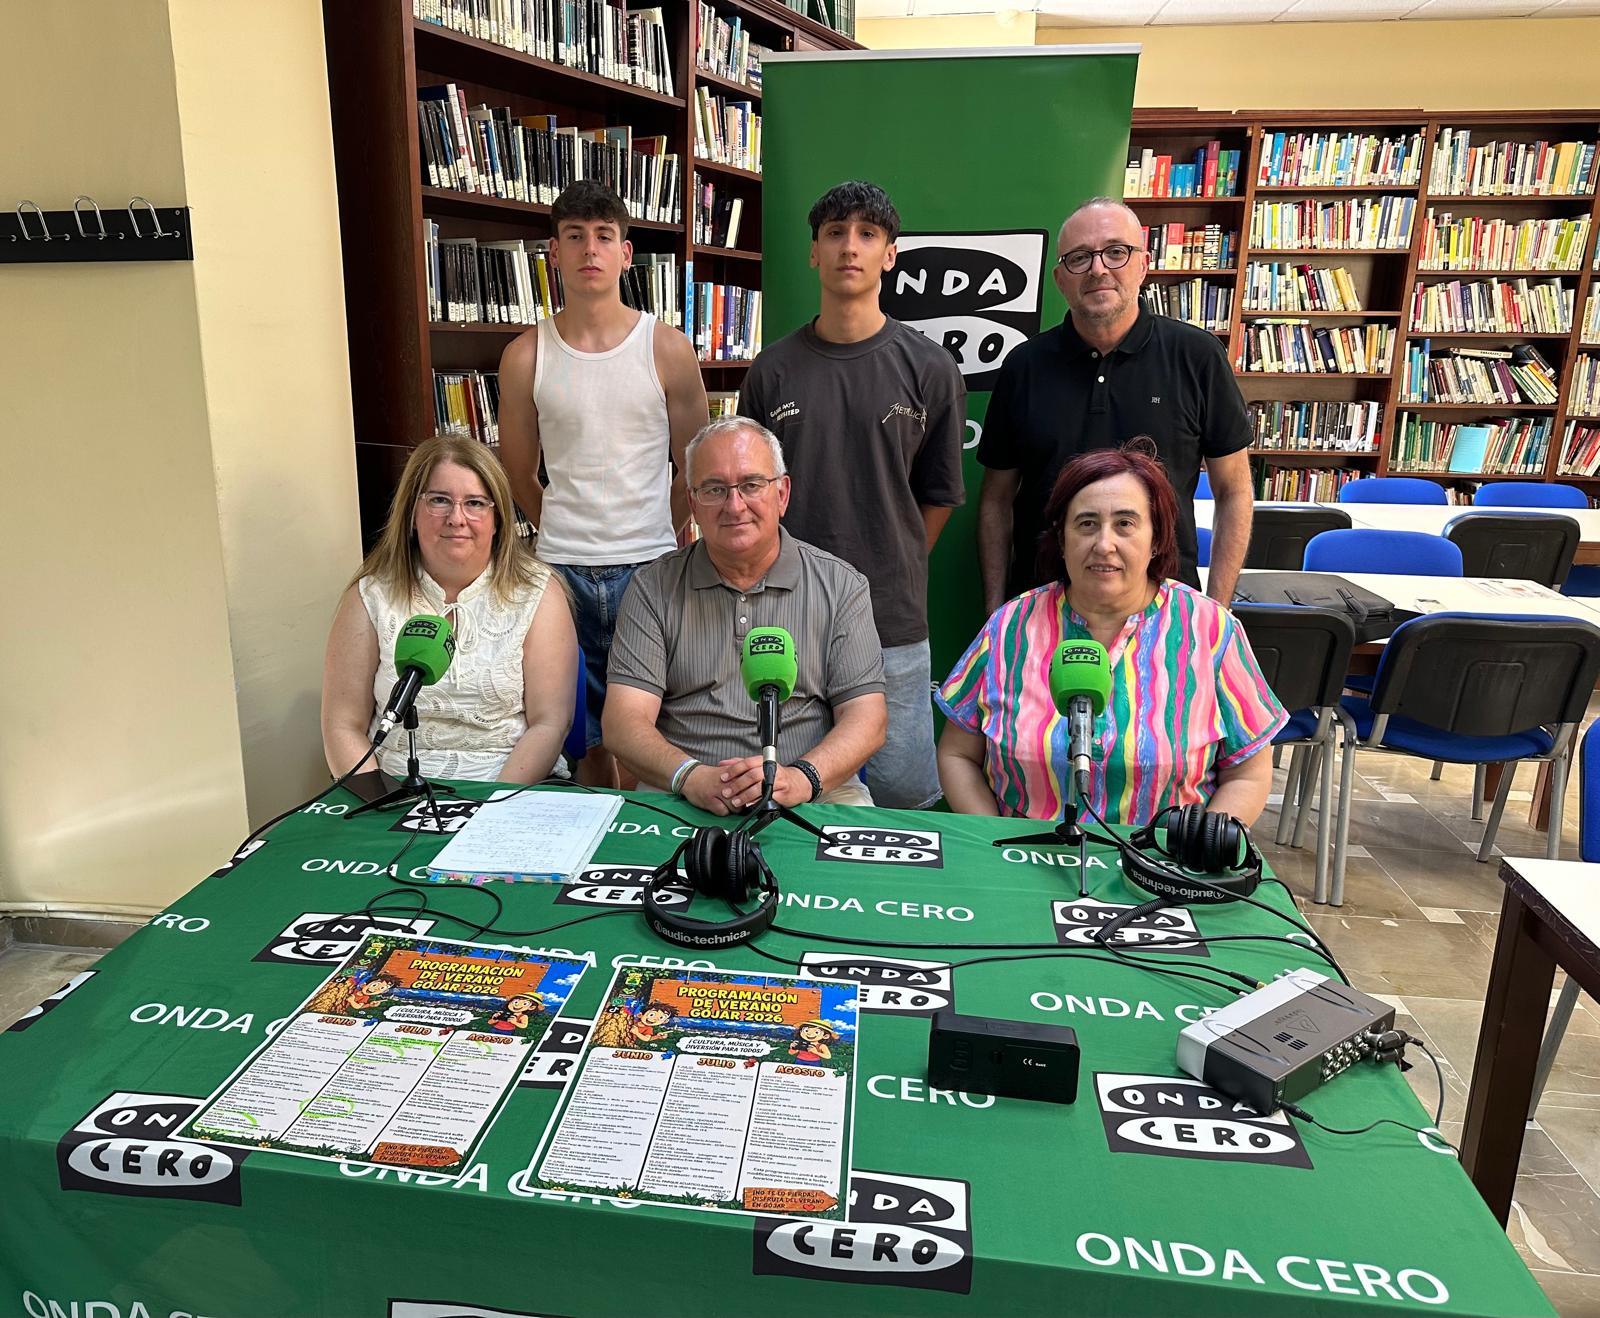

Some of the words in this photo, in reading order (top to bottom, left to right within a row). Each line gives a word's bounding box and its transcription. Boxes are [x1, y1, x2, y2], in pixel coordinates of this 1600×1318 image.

[880, 268, 1007, 296] NDA
[920, 330, 1004, 364] RO
[837, 832, 922, 845] ONDA
[840, 846, 923, 859] CERO
[1002, 848, 1109, 870] ONDA
[301, 858, 399, 877] ONDA
[589, 870, 653, 883] OND
[757, 891, 865, 913] ONDA
[875, 900, 975, 922] CERO
[1072, 907, 1173, 925] ONA
[662, 928, 751, 945] audio-technica
[410, 958, 525, 978] PROGRAMACIÓN
[419, 970, 440, 980] DE
[444, 973, 504, 985] VERANO
[412, 980, 460, 992] GÓJAR
[463, 985, 500, 995] 2026
[678, 986, 798, 1004] PROGRAMACIÓN
[693, 998, 713, 1008] DE
[718, 1000, 782, 1013] VERANO
[1030, 991, 1165, 1021] ONDA
[129, 1003, 255, 1034] ONDA
[318, 1016, 356, 1026] JUNIO
[690, 1008, 740, 1020] GÓJAR
[745, 1012, 783, 1023] 2026
[395, 1025, 432, 1035] JULIO
[466, 1033, 513, 1044] AGOSTO
[727, 1040, 754, 1048] MÚSICA
[612, 1050, 654, 1061] JUNIO
[697, 1057, 736, 1069] JULIO
[775, 1065, 826, 1078] AGOSTO
[111, 1109, 178, 1128] ON
[1140, 1121, 1271, 1148] CERO
[89, 1140, 213, 1179] CERO
[793, 1225, 938, 1265] CERO
[1075, 1232, 1266, 1285] ONDA
[1276, 1256, 1450, 1305] CERO
